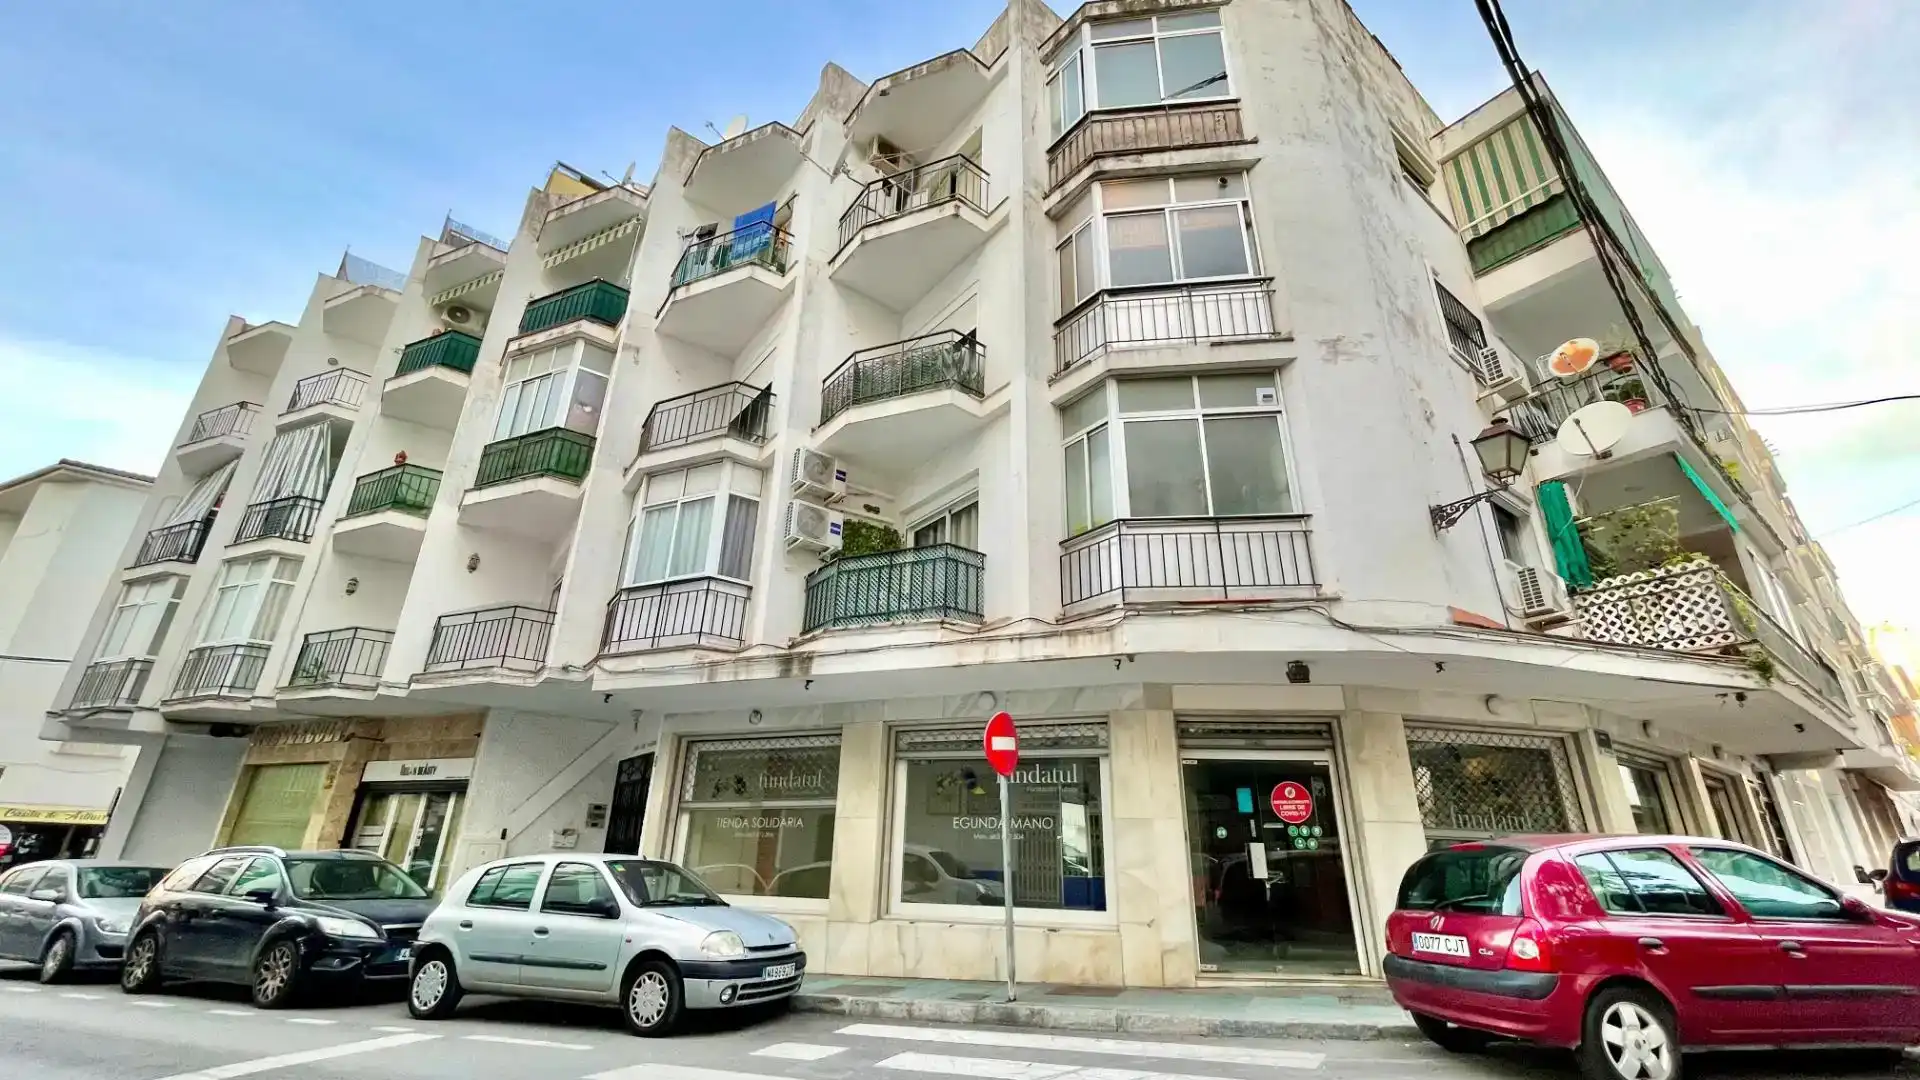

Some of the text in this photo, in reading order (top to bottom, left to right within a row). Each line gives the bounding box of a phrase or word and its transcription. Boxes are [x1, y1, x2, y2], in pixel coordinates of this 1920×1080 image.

[716, 816, 804, 829] TIENDA SOLIDARIA
[1010, 817, 1054, 829] MANO
[1419, 935, 1465, 953] 0077 CJT
